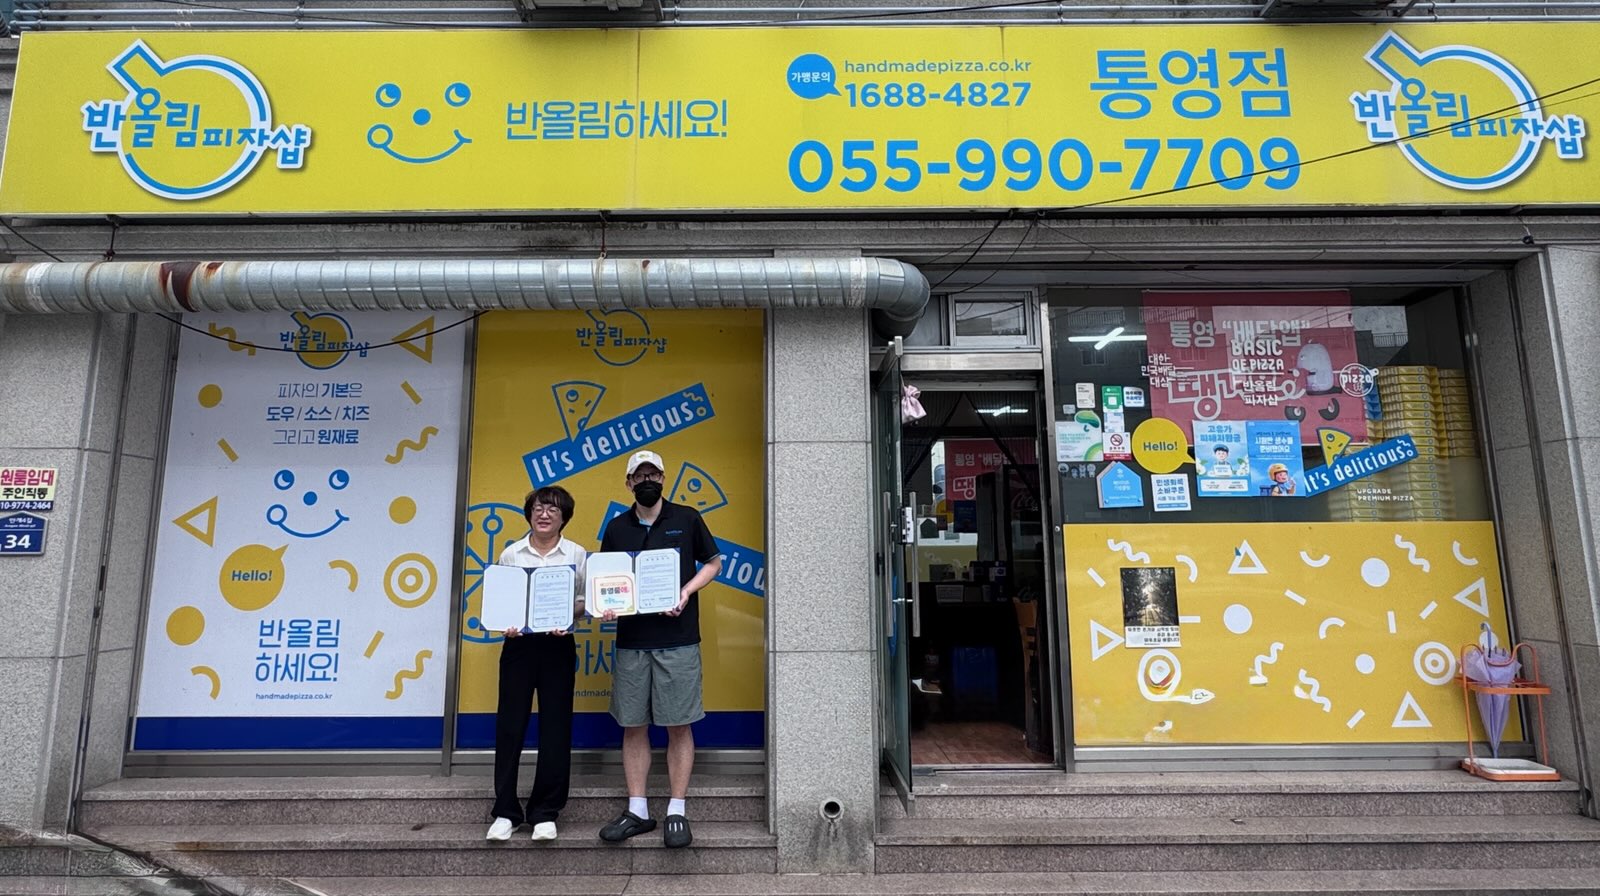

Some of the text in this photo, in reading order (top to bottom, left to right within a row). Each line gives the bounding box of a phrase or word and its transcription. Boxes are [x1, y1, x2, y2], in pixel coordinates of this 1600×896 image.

[844, 58, 1032, 75] handmadepizza.co.kr
[791, 71, 831, 83] 가맹문의
[1090, 48, 1293, 120] 통영점
[844, 82, 1032, 108] 1688-4827
[506, 99, 728, 140] 반올림하세요!
[788, 137, 1302, 194] 055-990-7709
[1169, 320, 1216, 348] 통영
[1231, 339, 1283, 356] BASIC
[1249, 358, 1285, 371] PIZZA
[278, 382, 363, 399] 피자의 기본은
[266, 406, 295, 421] 도우
[303, 406, 332, 421] 소스
[342, 406, 370, 421] 치즈
[273, 429, 360, 445] 그리고 원재료
[1143, 441, 1178, 451] Hello!
[531, 450, 575, 483] It's
[0, 469, 55, 487] 원룸임대
[1302, 471, 1330, 493] It's
[4, 534, 31, 549] 34
[231, 569, 273, 582] Hello!
[259, 619, 341, 649] 반올림
[255, 652, 340, 683] 하세요!
[256, 693, 333, 701] handmadepizza.co.kr
